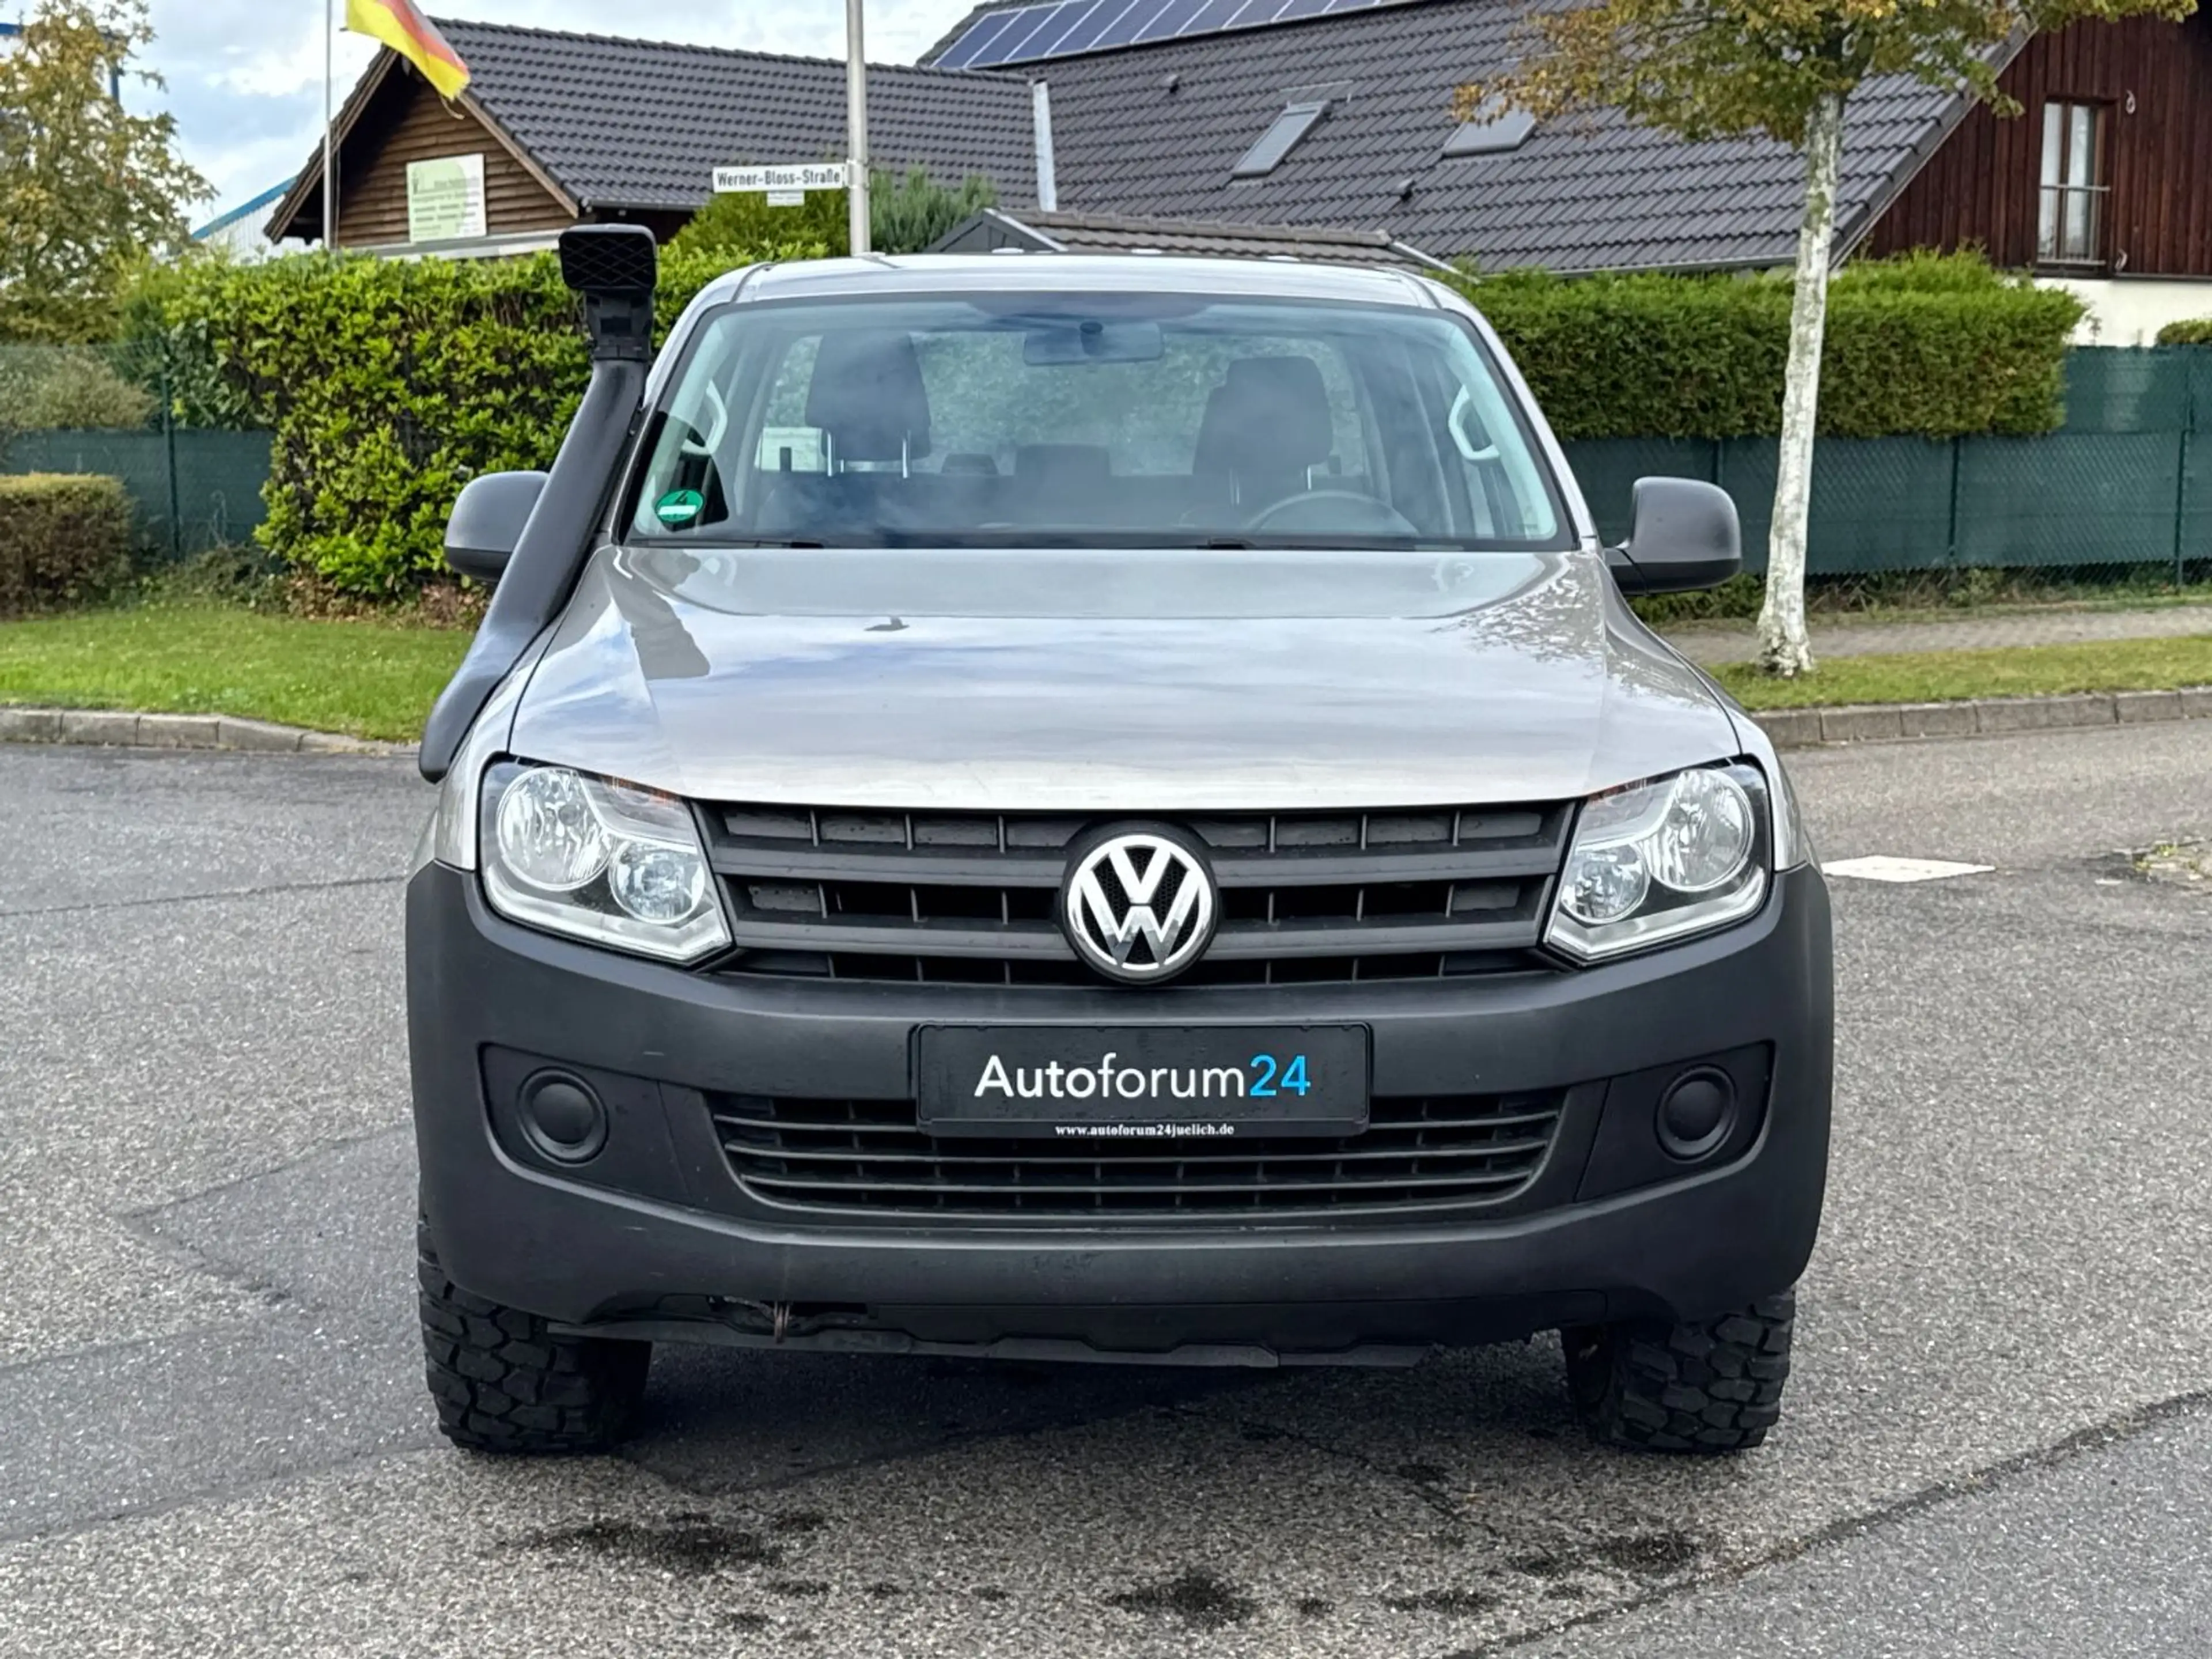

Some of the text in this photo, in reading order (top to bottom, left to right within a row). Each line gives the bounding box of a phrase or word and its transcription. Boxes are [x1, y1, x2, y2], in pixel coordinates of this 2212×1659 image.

[1071, 838, 1209, 974] VW
[974, 1052, 1311, 1098] Autoforum24
[1054, 1123, 1234, 1138] www.autoforum24juelich.de
